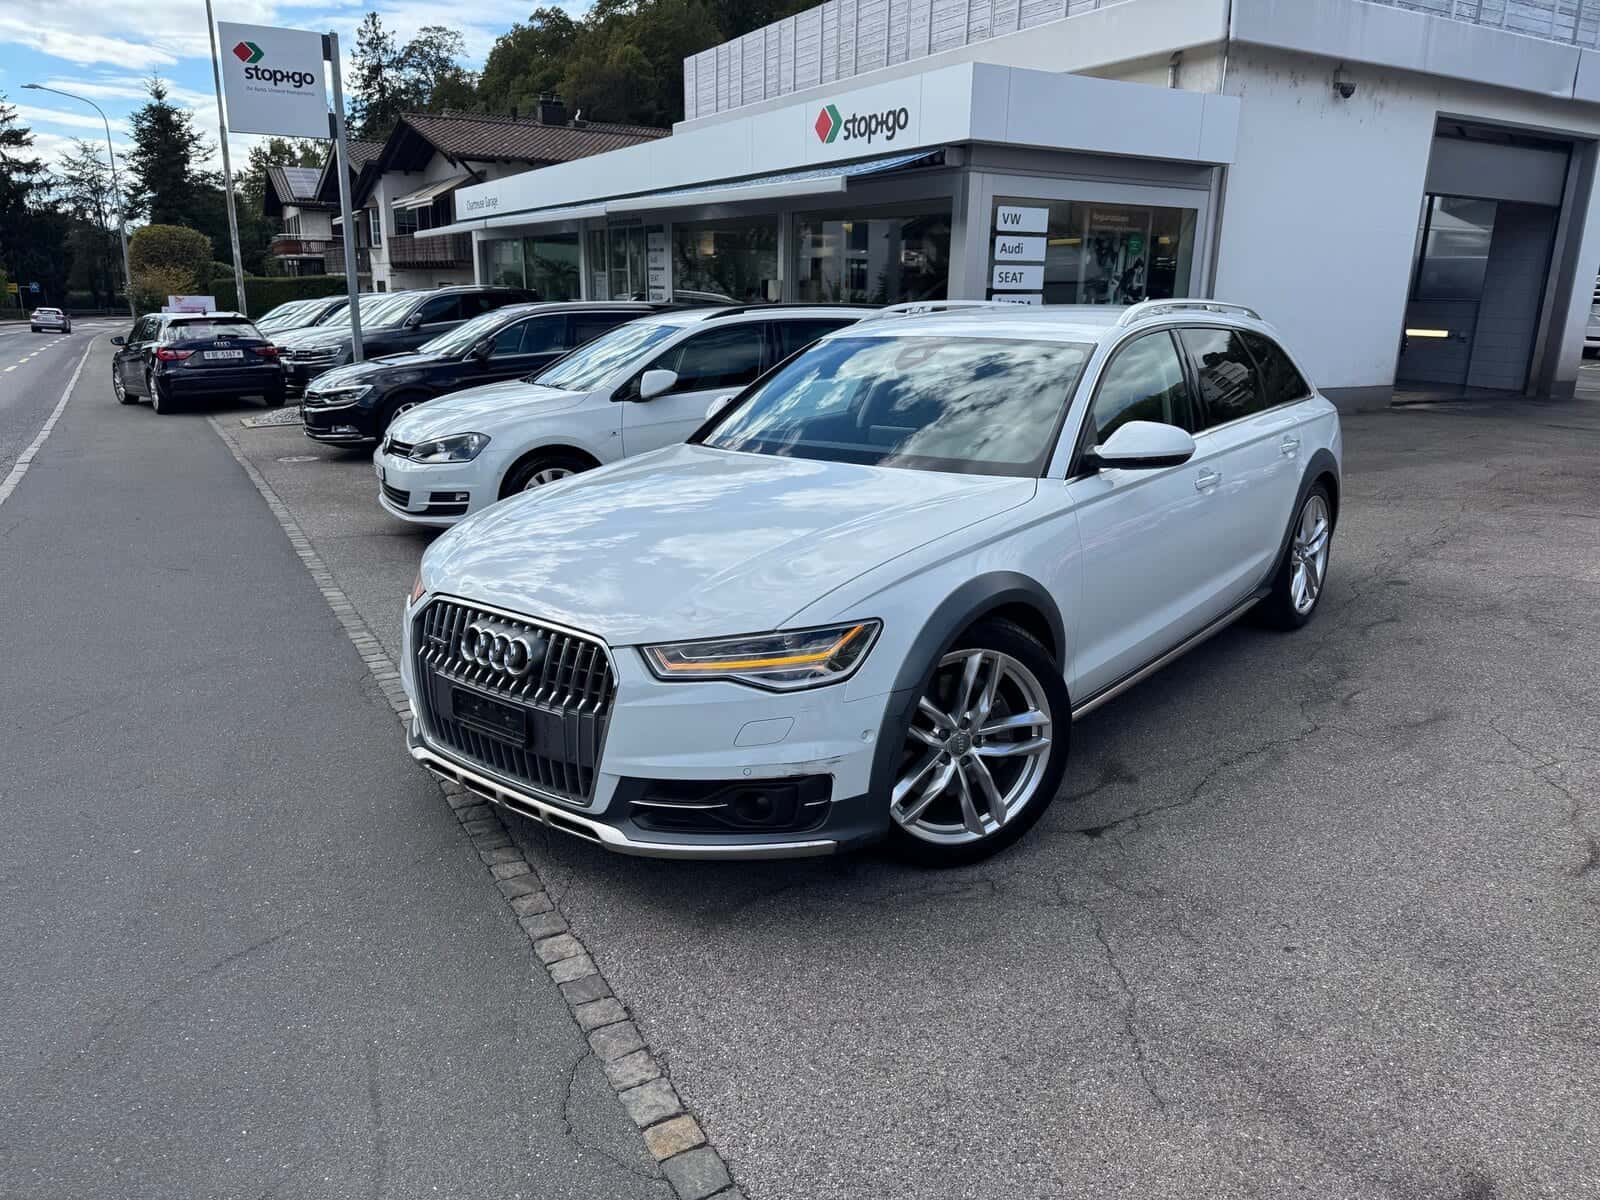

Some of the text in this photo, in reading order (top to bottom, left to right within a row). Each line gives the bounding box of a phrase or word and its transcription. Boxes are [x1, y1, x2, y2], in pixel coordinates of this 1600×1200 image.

[244, 65, 315, 88] stop+go
[843, 107, 909, 144] stop+go
[1002, 212, 1022, 225] VW
[1000, 242, 1024, 255] Audi
[998, 271, 1025, 284] SEAT
